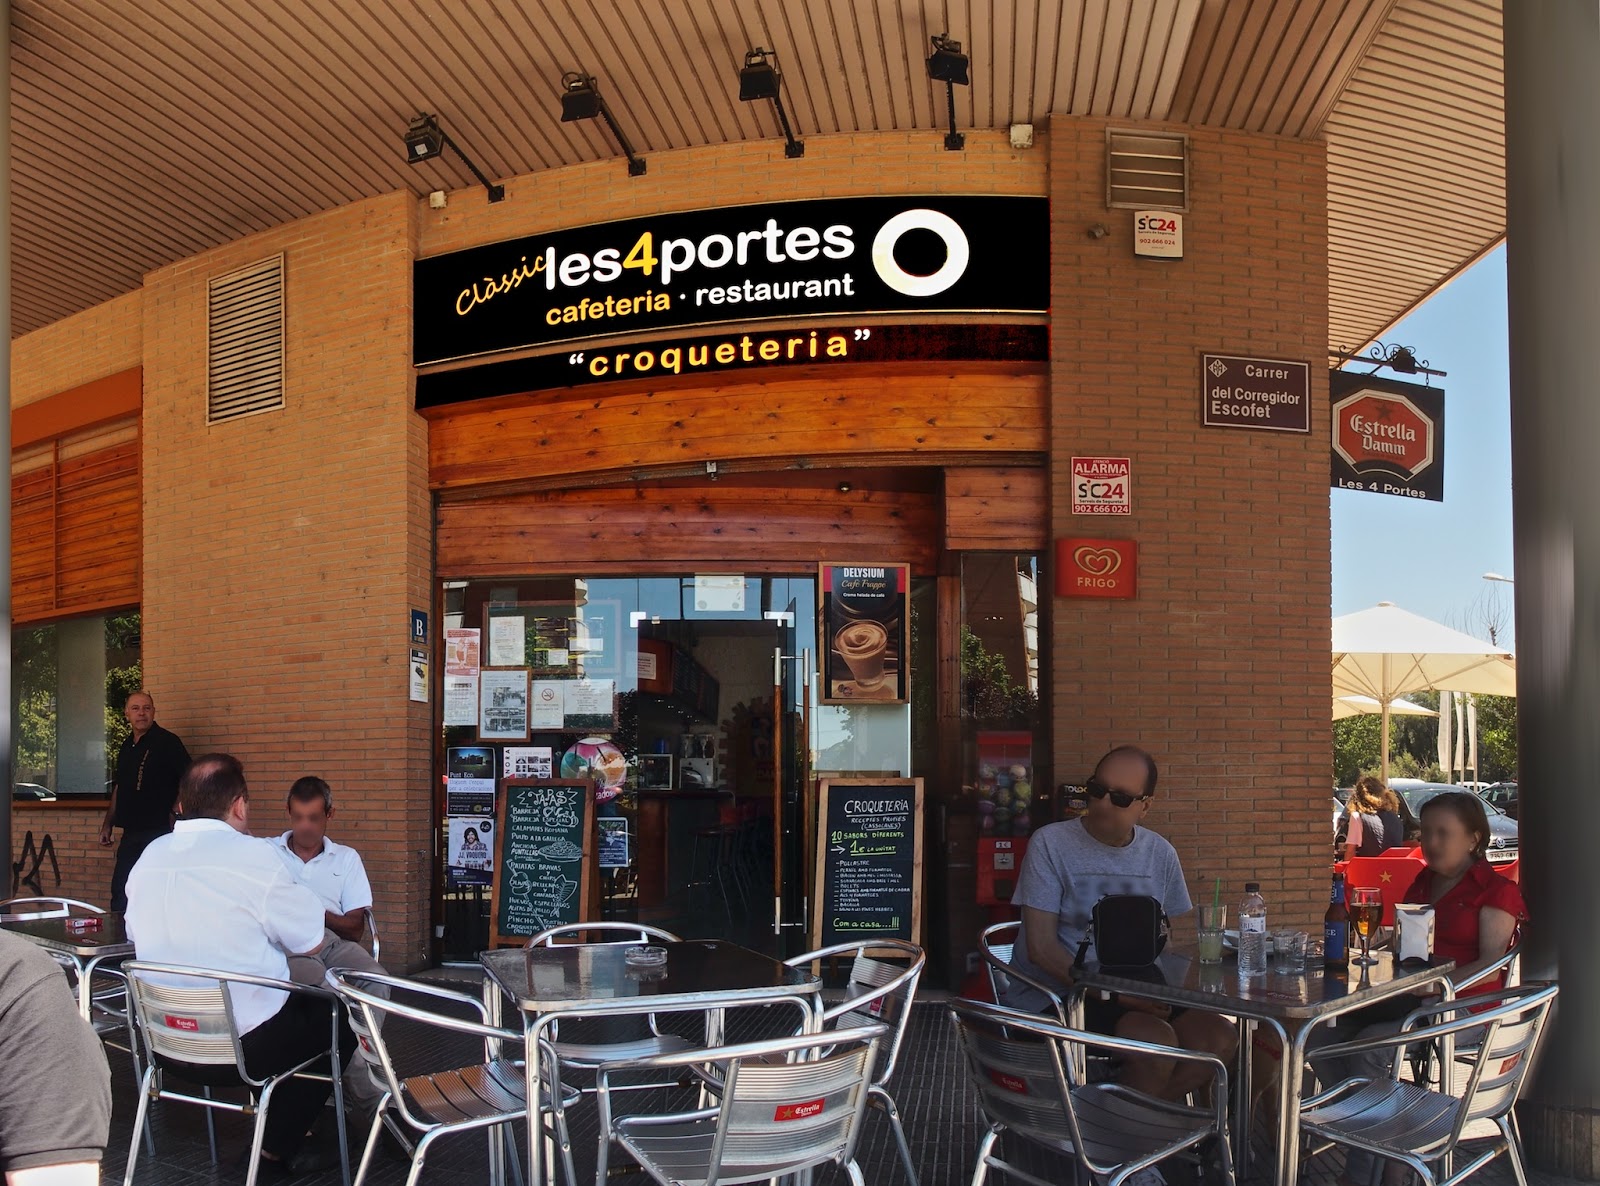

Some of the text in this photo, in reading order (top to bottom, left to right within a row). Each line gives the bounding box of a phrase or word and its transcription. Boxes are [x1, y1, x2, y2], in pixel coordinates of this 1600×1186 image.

[546, 272, 855, 326] cafeteria restaurant
[1245, 364, 1289, 380] Carrer
[1212, 386, 1300, 405] del Corregidor
[1212, 400, 1271, 418] Escofet
[1350, 413, 1416, 442] Estrella
[1362, 434, 1406, 456] Damm
[1075, 463, 1128, 474] ALARMA
[1339, 477, 1426, 498] Les 4 Portes
[844, 568, 884, 578] DELYSIUM
[842, 580, 860, 590] Café
[1078, 577, 1116, 588] FRIGO
[416, 619, 423, 636] B
[528, 789, 567, 806] TAPAS
[832, 830, 842, 840] 10
[511, 862, 535, 870] PATATAS
[833, 918, 849, 927] Com
[795, 1104, 820, 1114] Estrella
